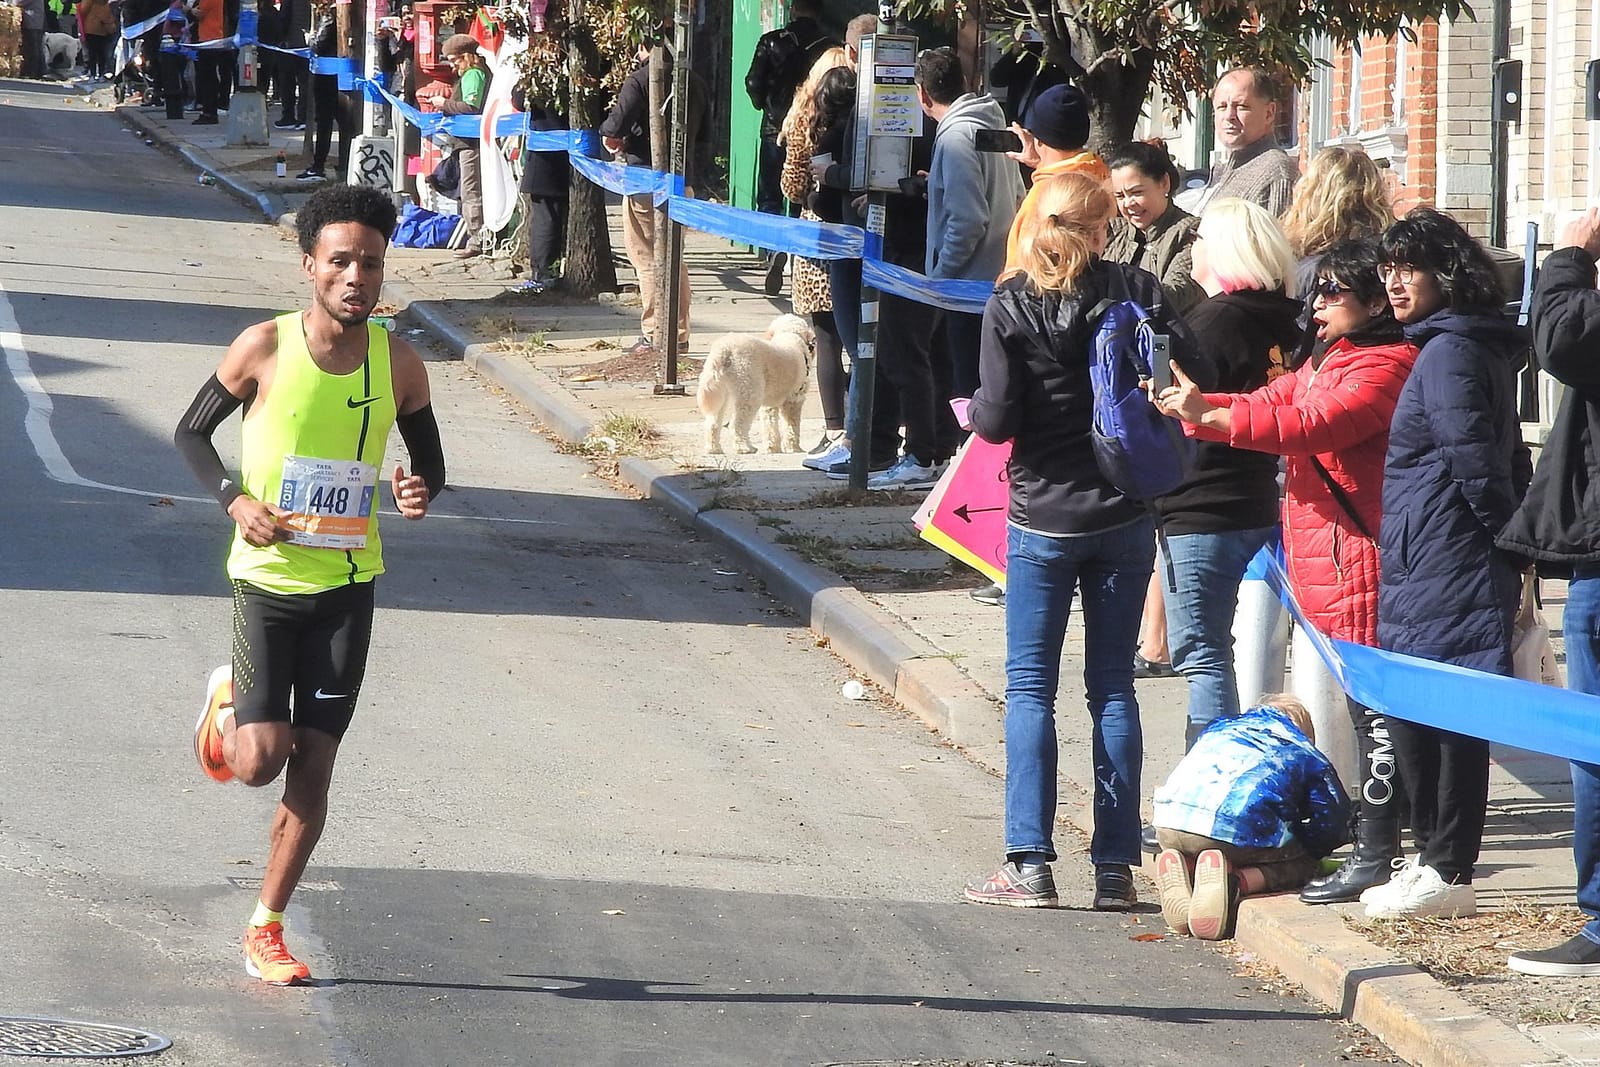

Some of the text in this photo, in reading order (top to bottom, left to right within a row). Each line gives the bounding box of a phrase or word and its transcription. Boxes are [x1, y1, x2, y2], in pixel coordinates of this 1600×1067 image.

[282, 482, 293, 508] 2019
[309, 486, 349, 515] 448
[1363, 718, 1395, 806] Calvin
